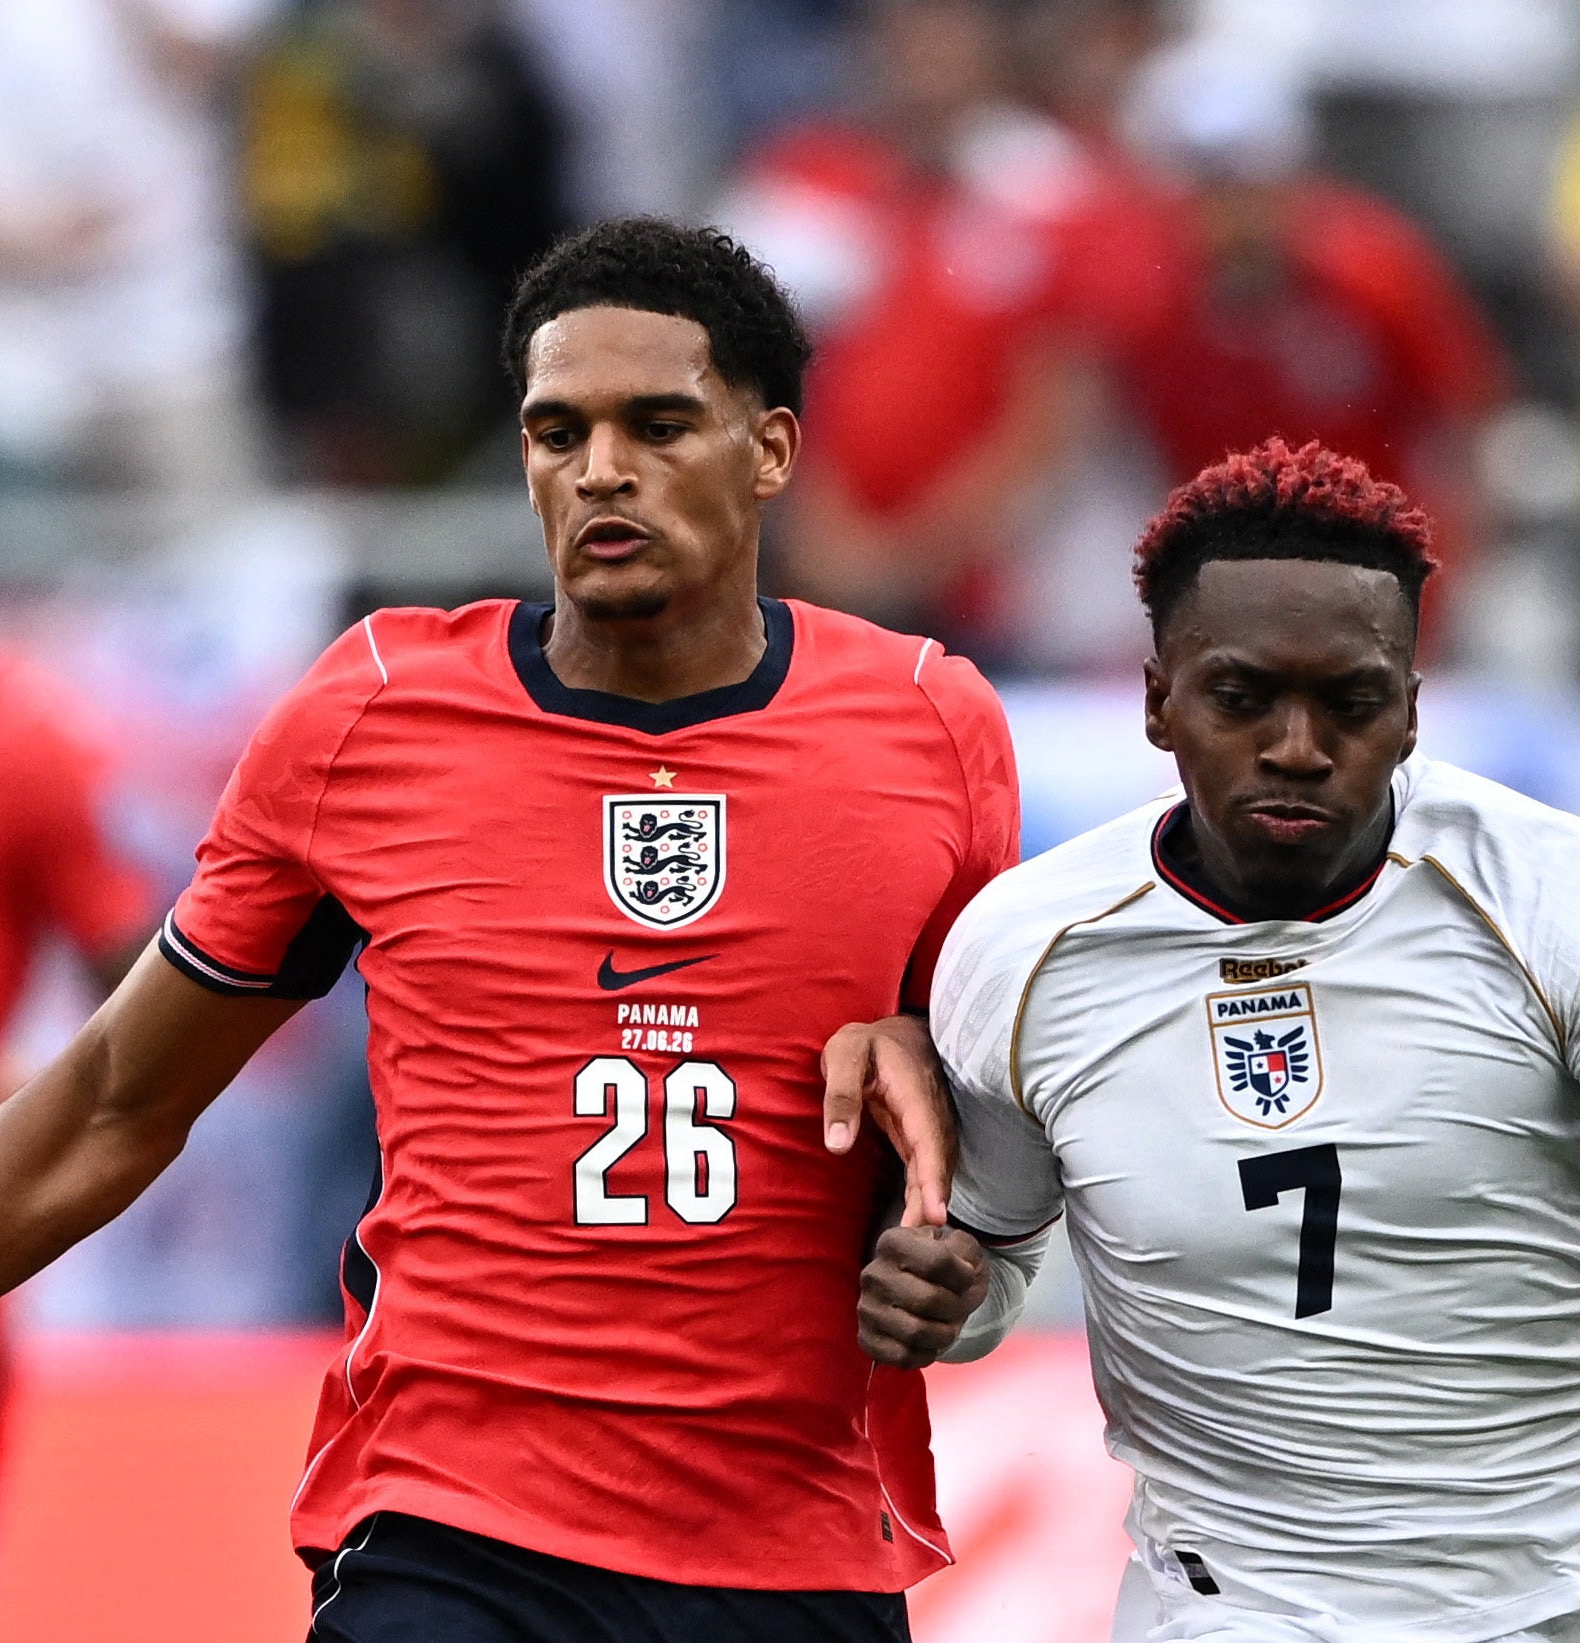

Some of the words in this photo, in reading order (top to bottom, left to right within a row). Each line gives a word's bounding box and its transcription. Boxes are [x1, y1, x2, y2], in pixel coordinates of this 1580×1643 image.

[617, 1004, 699, 1027] PANAMA
[1217, 991, 1302, 1018] PANAMA
[621, 1029, 693, 1053] 27.06.26
[573, 1056, 738, 1226] 26
[1237, 1143, 1342, 1320] 7
